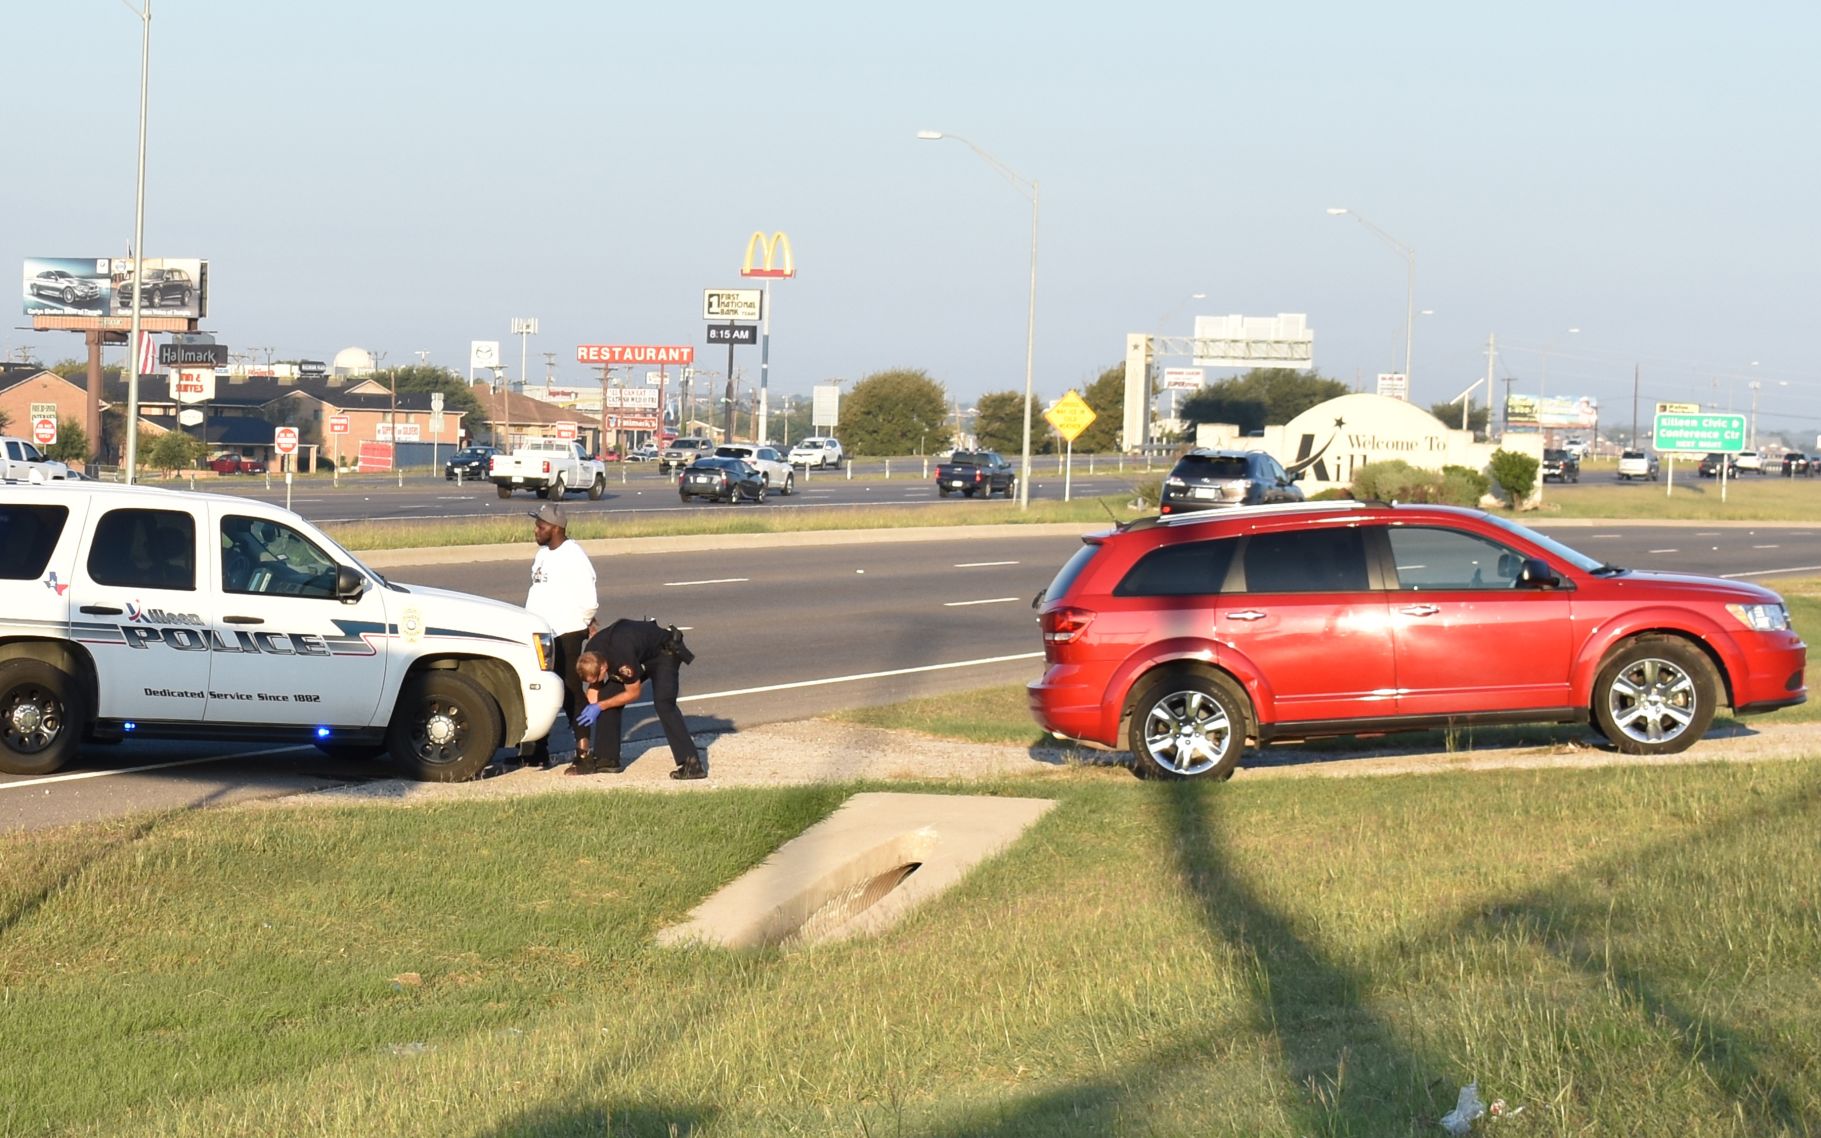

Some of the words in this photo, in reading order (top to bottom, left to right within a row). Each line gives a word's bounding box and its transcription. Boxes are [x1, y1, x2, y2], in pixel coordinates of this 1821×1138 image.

[721, 301, 756, 309] NATIONAL
[709, 329, 731, 339] 8:15
[732, 330, 749, 339] AM
[162, 347, 217, 364] Hallmark
[577, 347, 692, 361] RESTAURANT
[1661, 417, 1698, 428] Killeen
[1702, 418, 1728, 428] Civic
[1659, 429, 1720, 439] Conference
[1723, 430, 1741, 440] Ctr
[1348, 434, 1419, 450] Welcome
[1425, 436, 1447, 451] To
[125, 598, 206, 626] Killeen
[119, 625, 331, 657] POLICE
[144, 687, 204, 699] Dedicated
[208, 690, 253, 701] Service
[257, 692, 289, 702] Since
[293, 694, 321, 703] 1882
